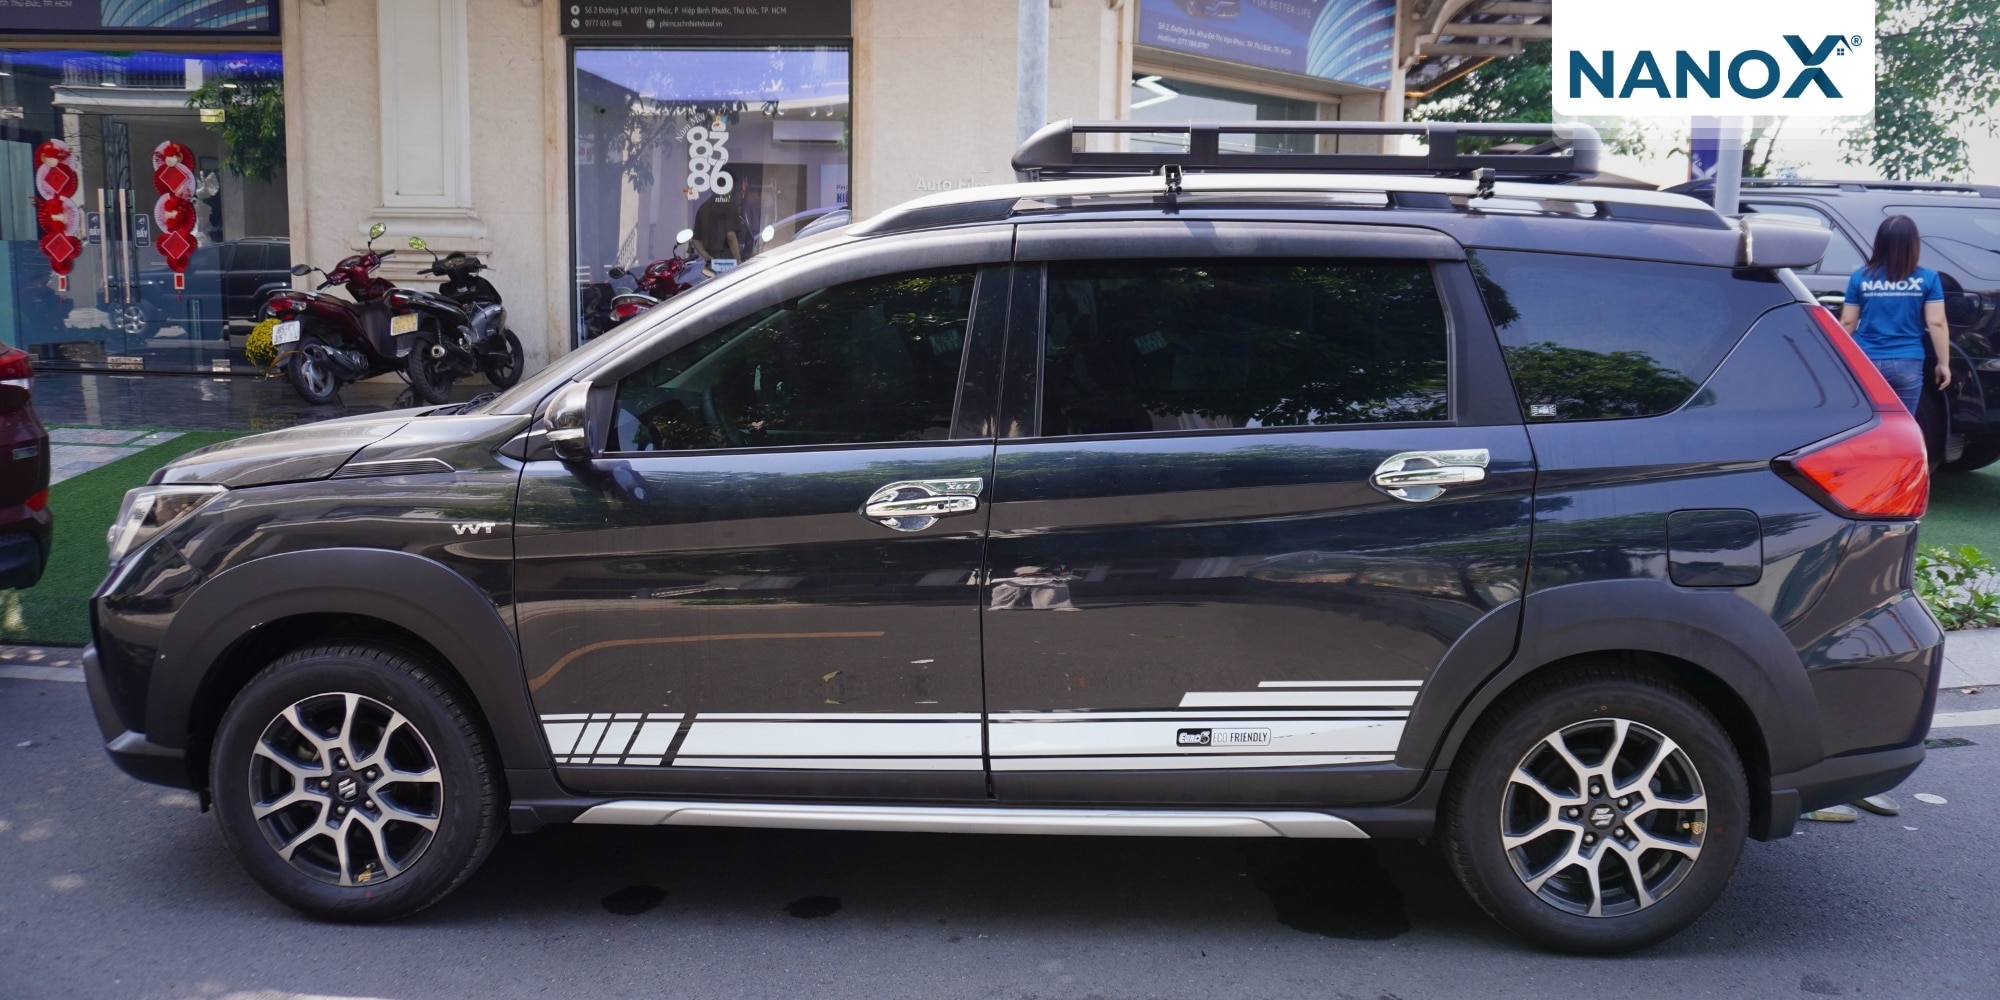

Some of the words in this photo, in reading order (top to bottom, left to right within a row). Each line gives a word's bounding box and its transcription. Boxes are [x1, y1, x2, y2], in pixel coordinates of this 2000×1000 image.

[1270, 1, 1295, 13] BETTER
[1297, 7, 1312, 18] LIFE
[915, 177, 951, 191] Auto
[1862, 277, 1922, 291] NANOX
[1213, 732, 1228, 743] ECO
[1230, 732, 1268, 743] FRIENDLY
